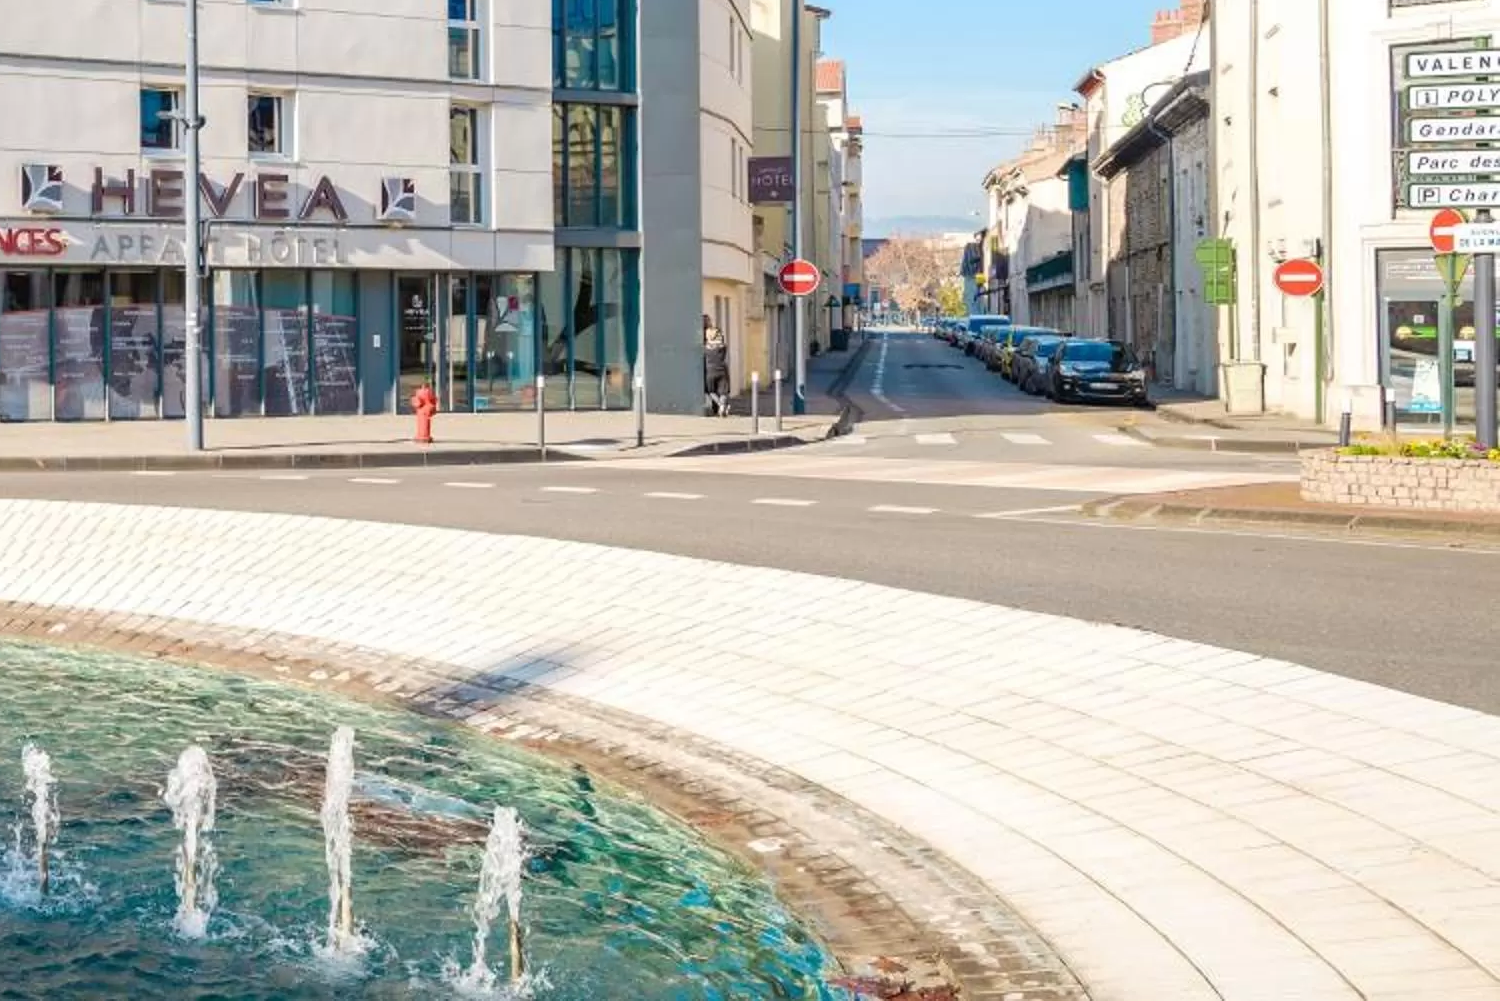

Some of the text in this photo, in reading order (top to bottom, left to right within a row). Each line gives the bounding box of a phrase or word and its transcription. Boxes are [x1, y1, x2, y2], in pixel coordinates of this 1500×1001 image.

[1417, 56, 1500, 71] VALEN
[1419, 123, 1500, 137] Gendar
[1417, 157, 1459, 170] Parc
[92, 167, 348, 219] HEVEA
